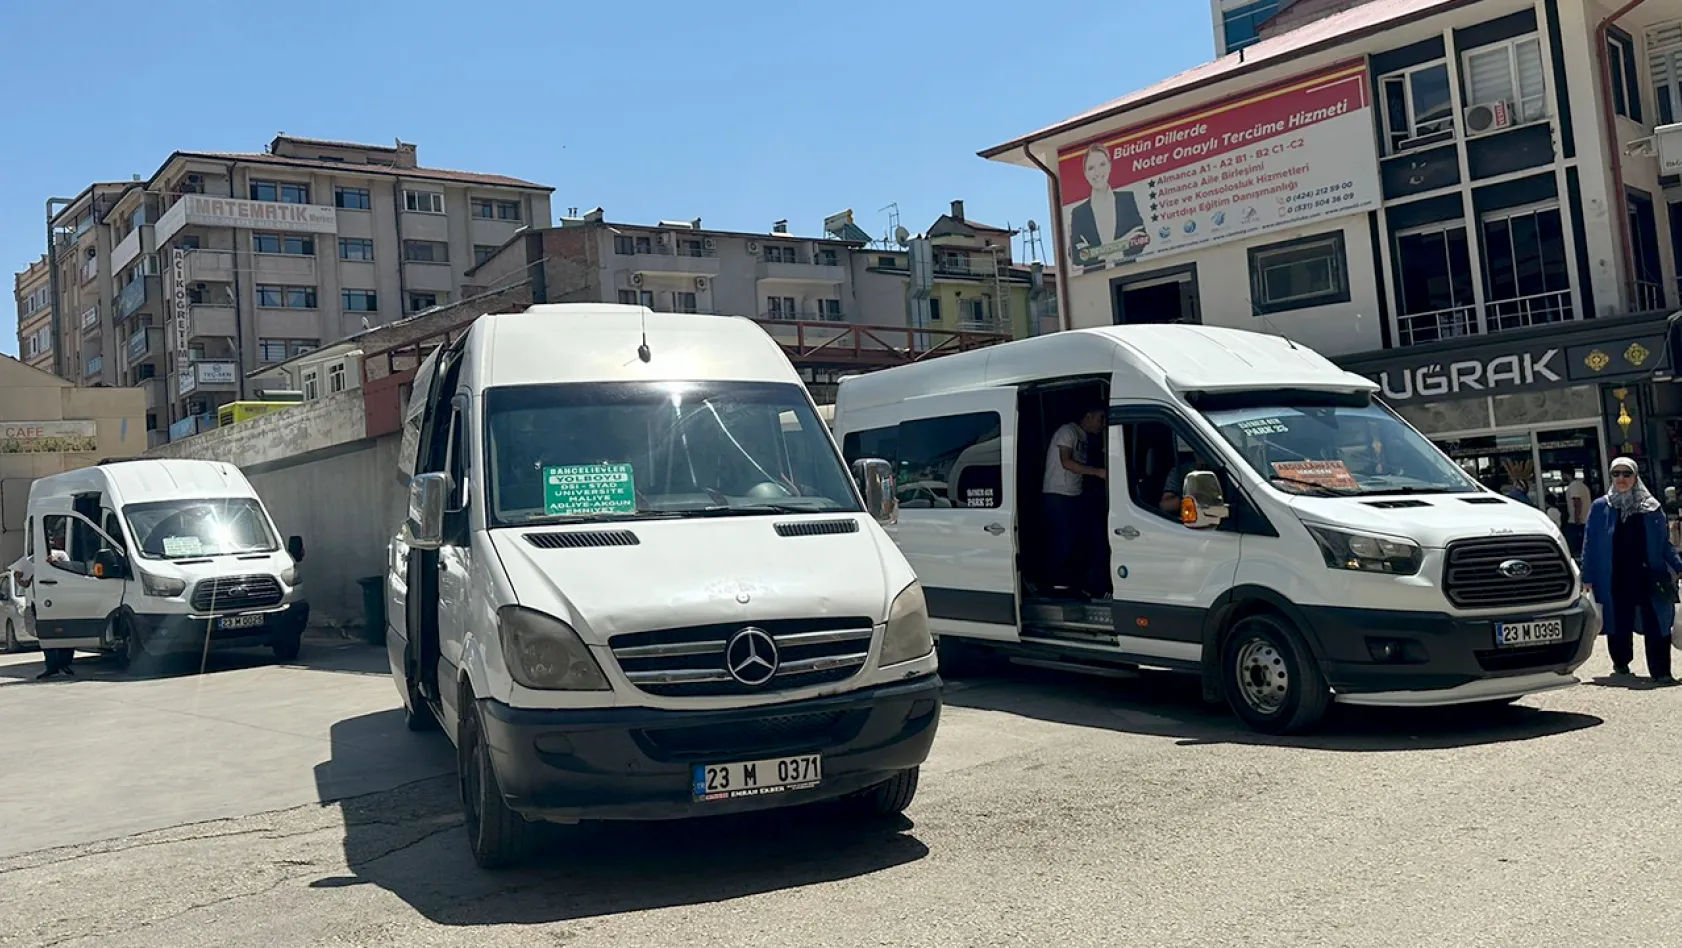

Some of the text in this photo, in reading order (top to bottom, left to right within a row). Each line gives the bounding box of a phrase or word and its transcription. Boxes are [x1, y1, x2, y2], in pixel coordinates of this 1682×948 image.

[1113, 123, 1208, 160] Bütün Dillerde
[1132, 98, 1348, 172] Noter Onaylı Tercüme Hizmeti
[1157, 168, 1197, 186] Almanca
[1199, 164, 1210, 174] A1
[1219, 157, 1233, 168] A2
[1235, 153, 1247, 164] B1
[1255, 148, 1269, 159] B2
[1271, 143, 1284, 154] C1
[1158, 160, 1265, 198] Almanca Aile Birleşimi
[1158, 162, 1310, 209] Vize ve Konsolosluk Hizmetleri
[1160, 181, 1299, 221] Yurtdışı Eğitim Danışmanlığı
[1315, 187, 1328, 196] 212
[1380, 348, 1562, 400] UĞRAK
[5, 427, 45, 437] CAFE
[556, 473, 622, 483] YOLBOYU
[222, 618, 233, 628] 23
[234, 617, 241, 626] M
[1503, 622, 1560, 641] 23 M 0396
[707, 766, 730, 790] 23
[743, 763, 757, 786] M
[778, 756, 818, 782] 0371
